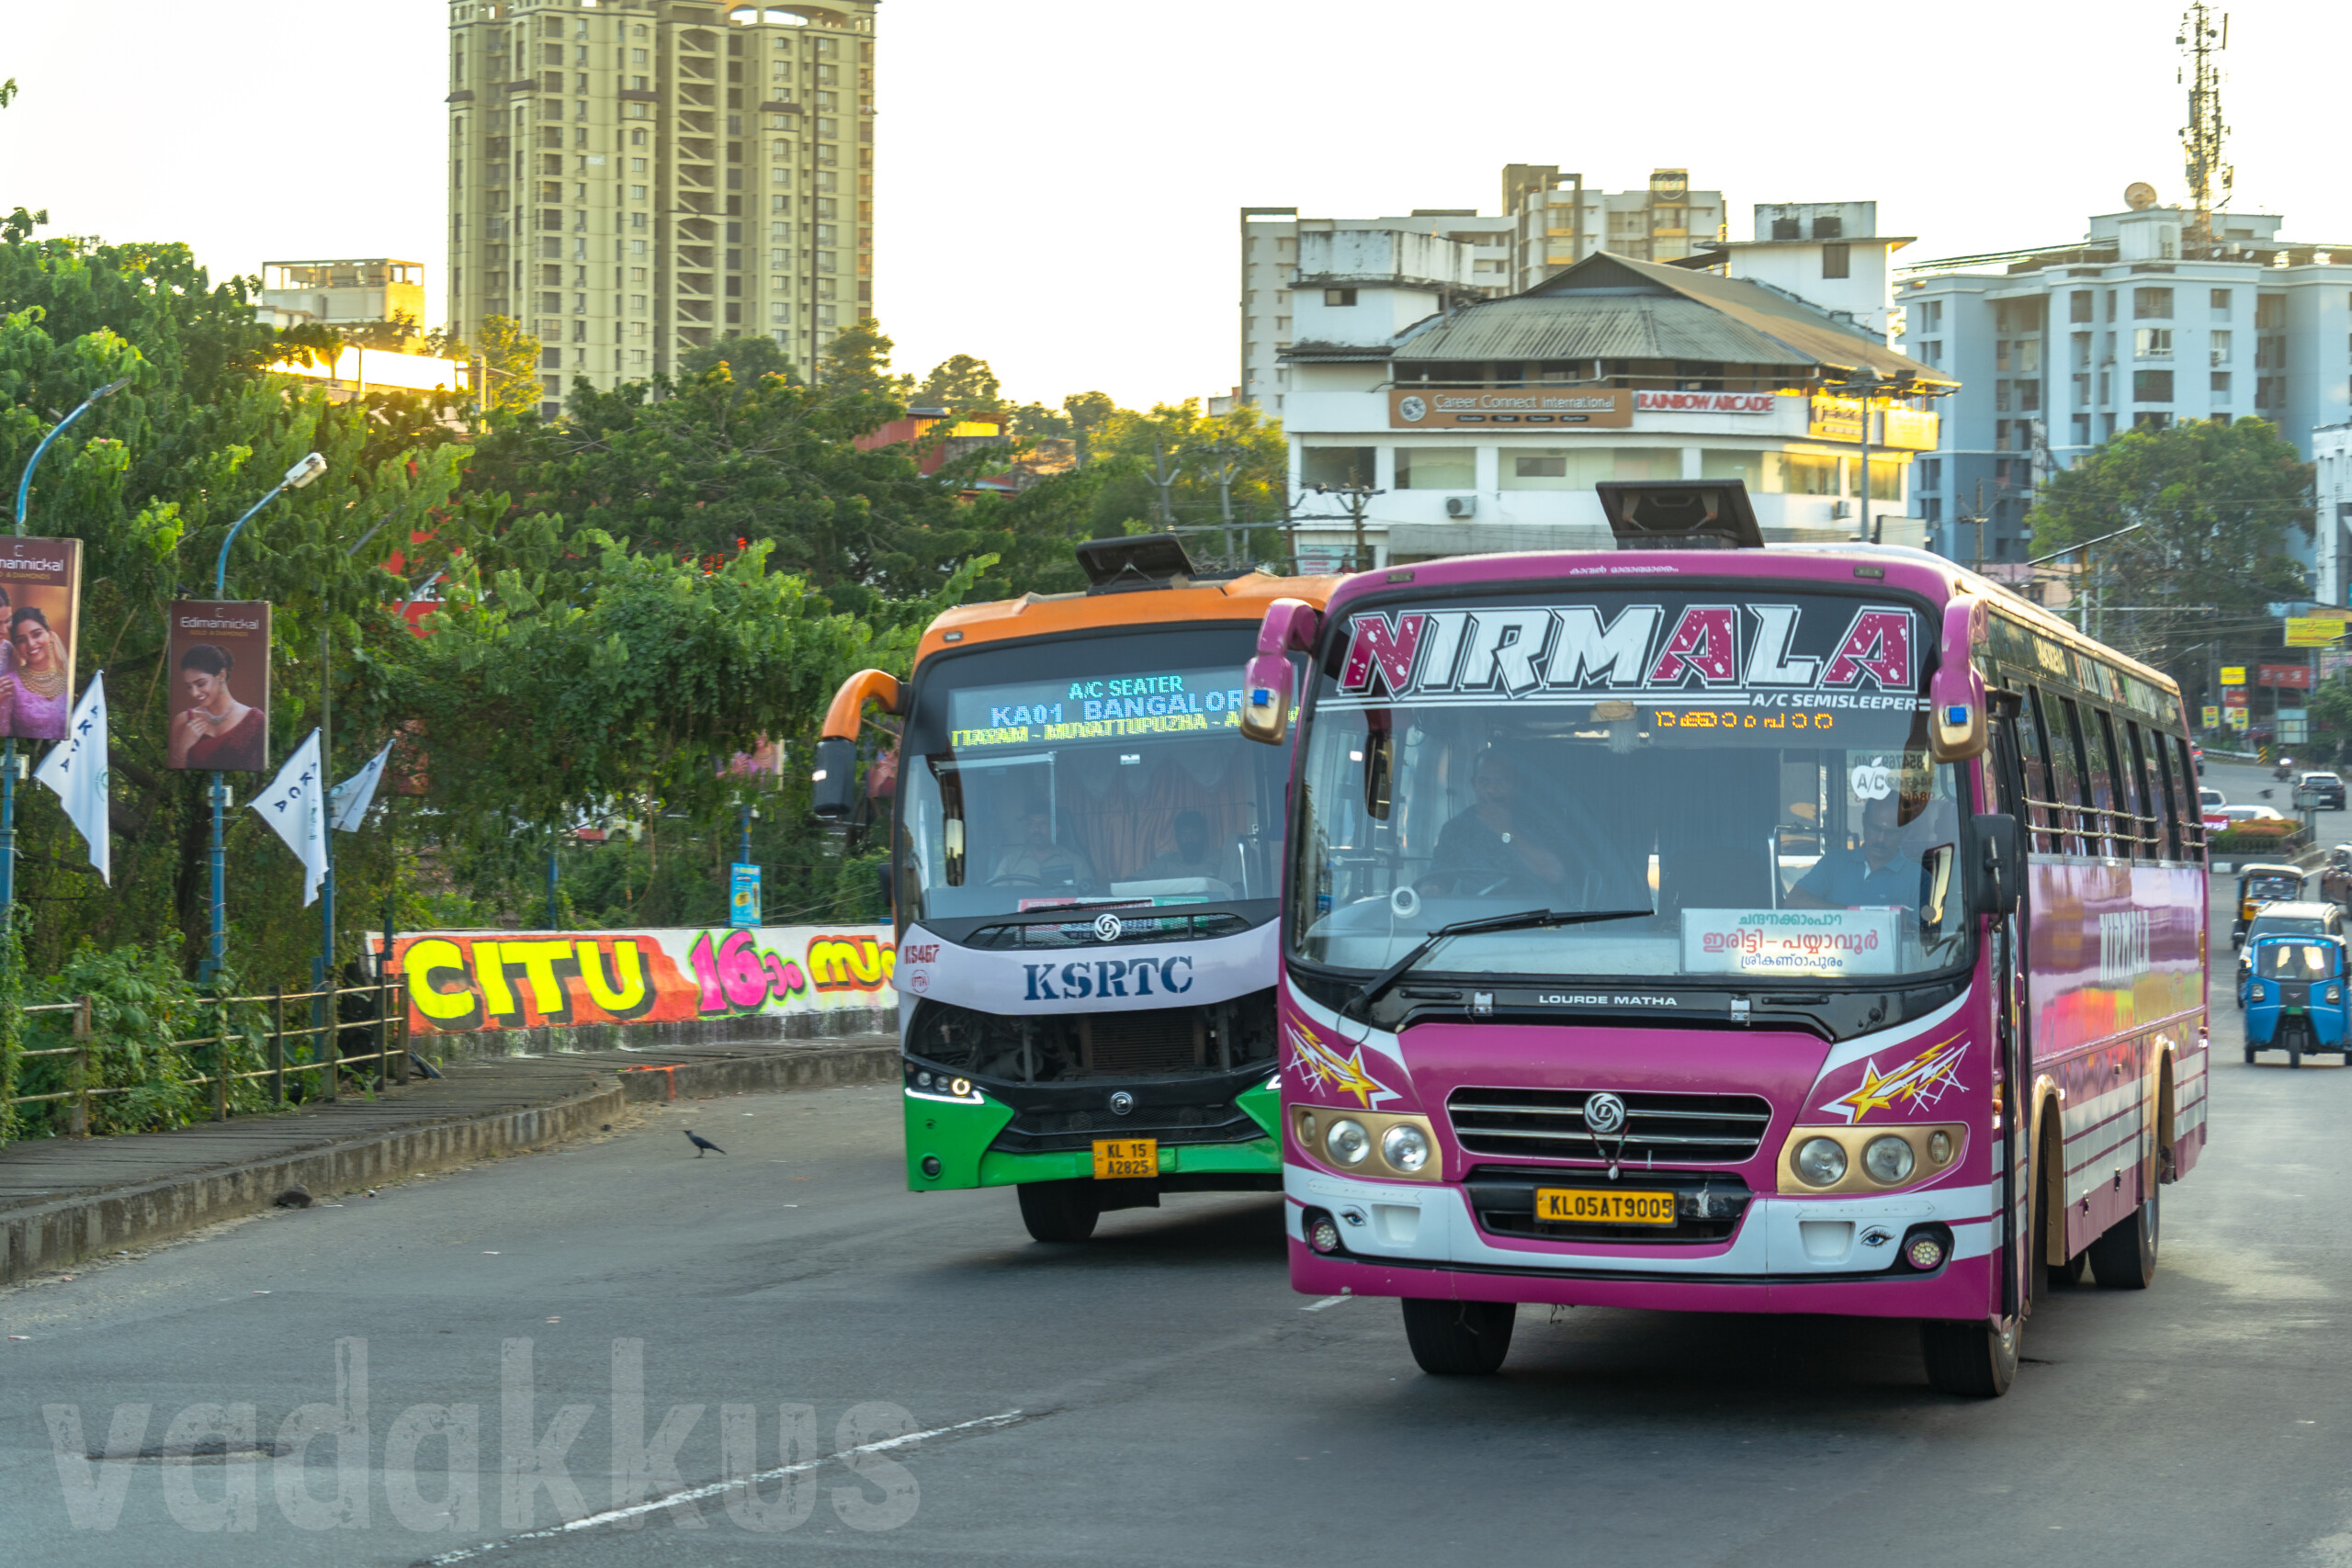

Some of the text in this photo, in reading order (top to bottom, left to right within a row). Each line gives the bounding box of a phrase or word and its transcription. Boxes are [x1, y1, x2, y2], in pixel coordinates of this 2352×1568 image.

[1432, 394, 1615, 409] Career Connect International
[1638, 393, 1774, 412] RAINBOW ARCADE
[179, 616, 259, 630] Edimannickal
[1337, 604, 1919, 701] NIRMALA
[1108, 675, 1183, 697] SEATER
[1752, 693, 1918, 712] A/C SEMISLEEPER
[990, 703, 1063, 728] KA01
[1857, 772, 1885, 793] A/C
[1703, 928, 1763, 953] ഇരിട്ടി
[1782, 930, 1879, 954] പയ്യാവൂർ
[904, 944, 940, 964] KS467
[402, 937, 652, 1023] CITU
[1023, 955, 1193, 1001] KSRTC
[1539, 995, 1678, 1006] LOURDE MATHA
[1108, 1144, 1147, 1158] KL 15
[1108, 1160, 1148, 1174] A2825
[1550, 1195, 1673, 1219] KL05AT9005
